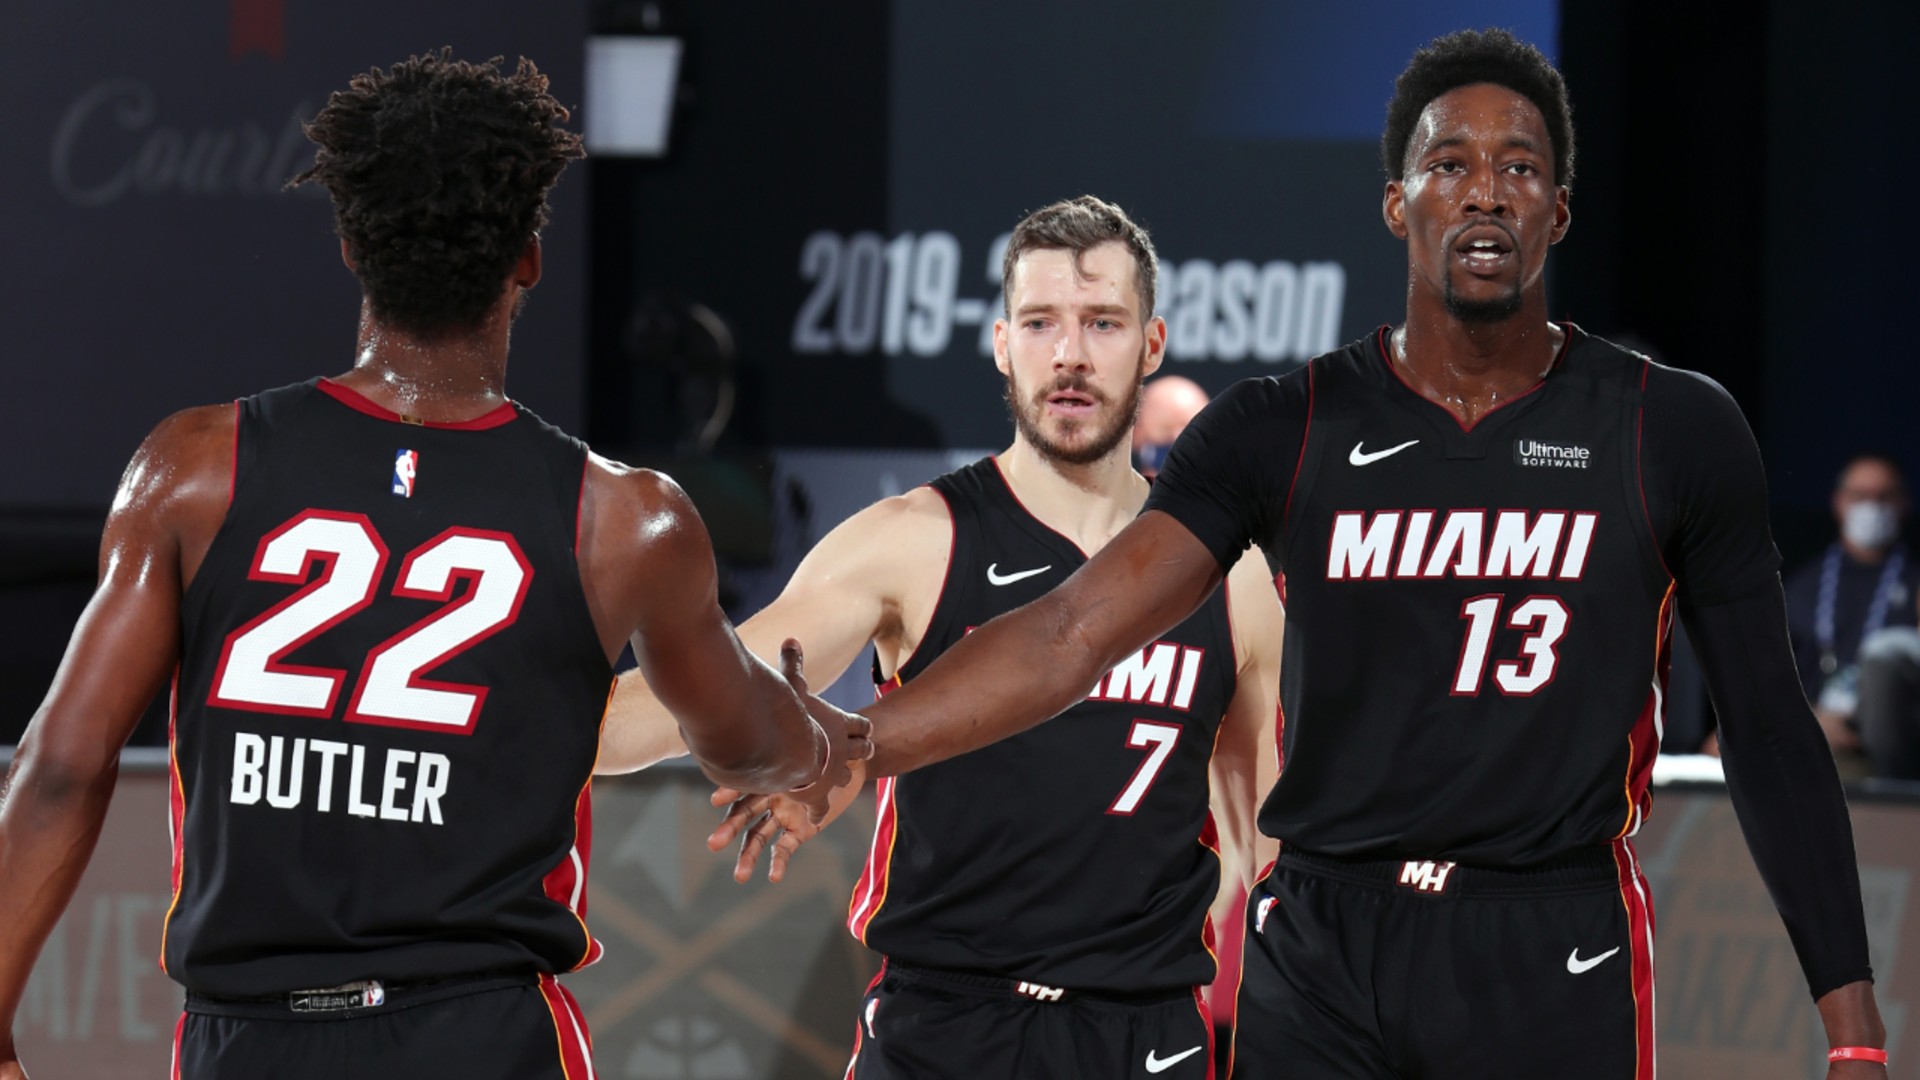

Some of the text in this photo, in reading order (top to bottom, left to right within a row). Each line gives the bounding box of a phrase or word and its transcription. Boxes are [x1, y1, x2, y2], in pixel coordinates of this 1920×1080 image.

[49, 75, 324, 208] Court
[1519, 440, 1590, 459] Ultimate
[1521, 458, 1587, 468] SOFTWARE
[1324, 507, 1600, 582] MIAMI
[205, 507, 535, 737] 22
[1450, 593, 1572, 697] 13
[230, 732, 451, 826] BUTLER
[1105, 718, 1184, 817] 7
